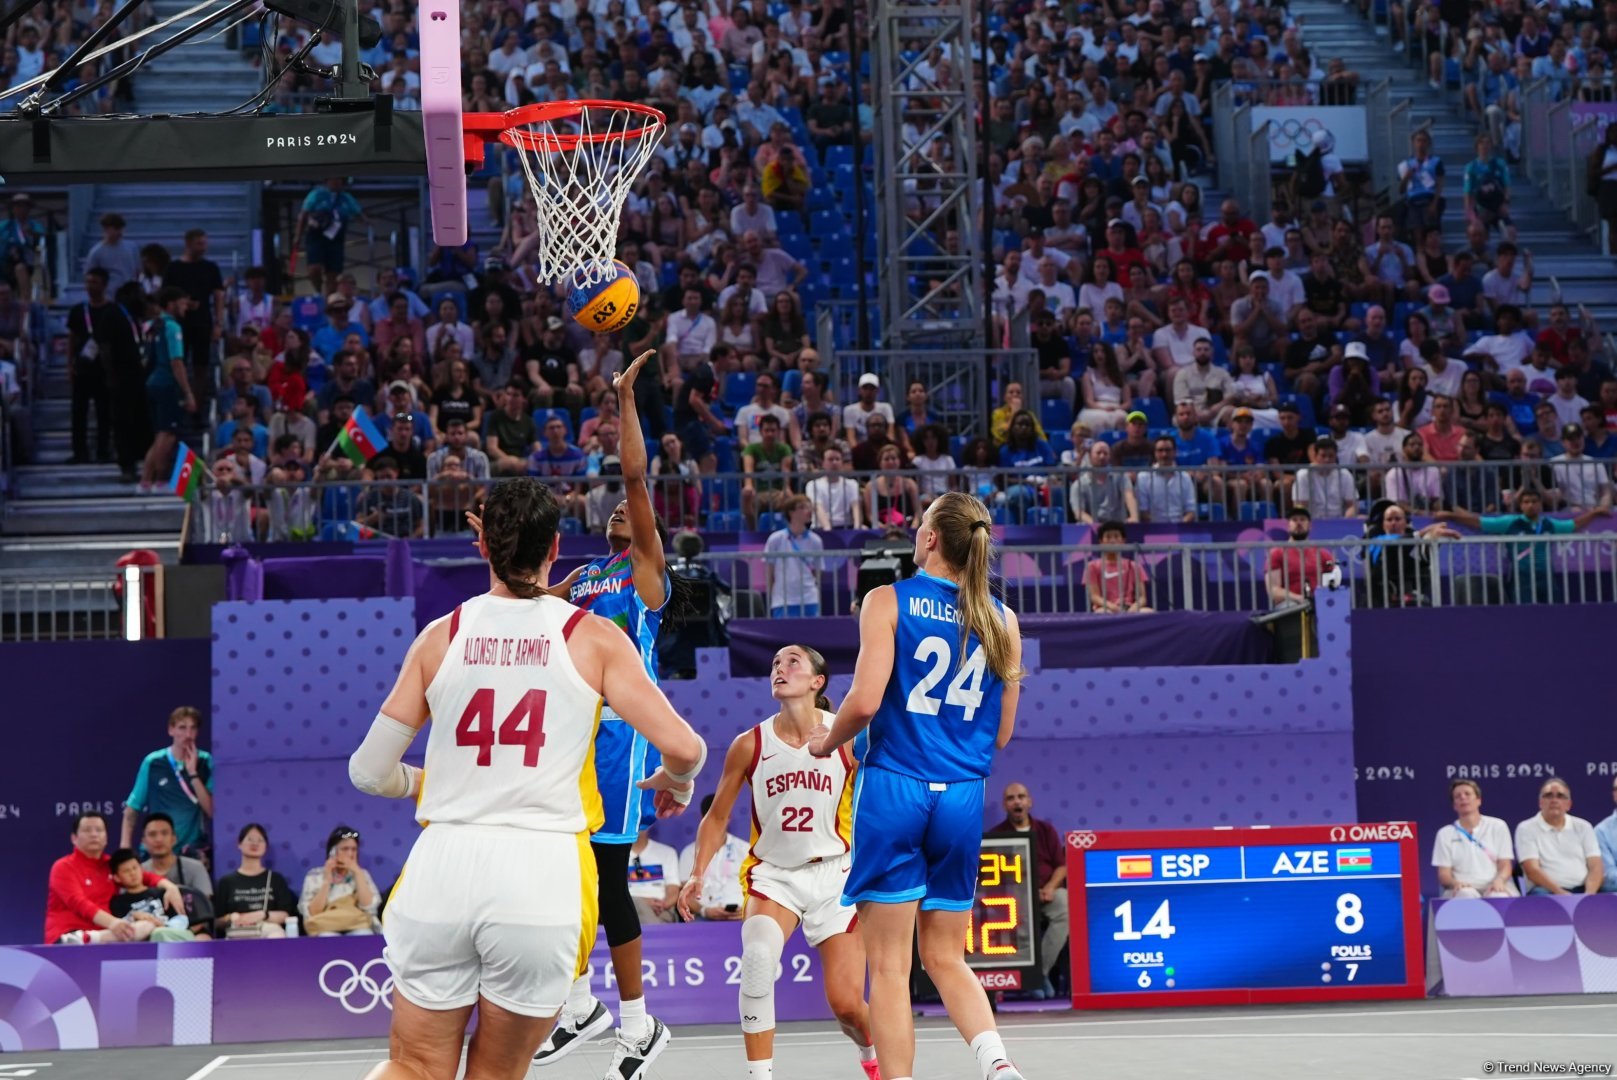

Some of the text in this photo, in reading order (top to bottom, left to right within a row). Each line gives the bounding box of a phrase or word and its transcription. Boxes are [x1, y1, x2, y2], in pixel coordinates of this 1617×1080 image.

[317, 133, 356, 146] 2024
[463, 634, 551, 667] ALONSO DE ARMIÑO
[906, 636, 985, 721] 24
[456, 688, 547, 768] 44
[1365, 766, 1415, 781] 2024
[1506, 762, 1556, 778] 2024
[765, 768, 832, 798] ESPAÑA
[0, 803, 20, 819] 24
[781, 806, 814, 832] 22
[1349, 825, 1414, 841] OMEGA
[1160, 853, 1210, 878] ESP
[1271, 850, 1330, 875] AZE
[1113, 899, 1176, 941] 14
[1335, 892, 1364, 934] 8
[1123, 951, 1164, 964] FOULS
[1331, 944, 1372, 957] FOULS
[979, 973, 1018, 988] MEGA
[1137, 970, 1152, 988] 6
[1345, 963, 1359, 981] 7
